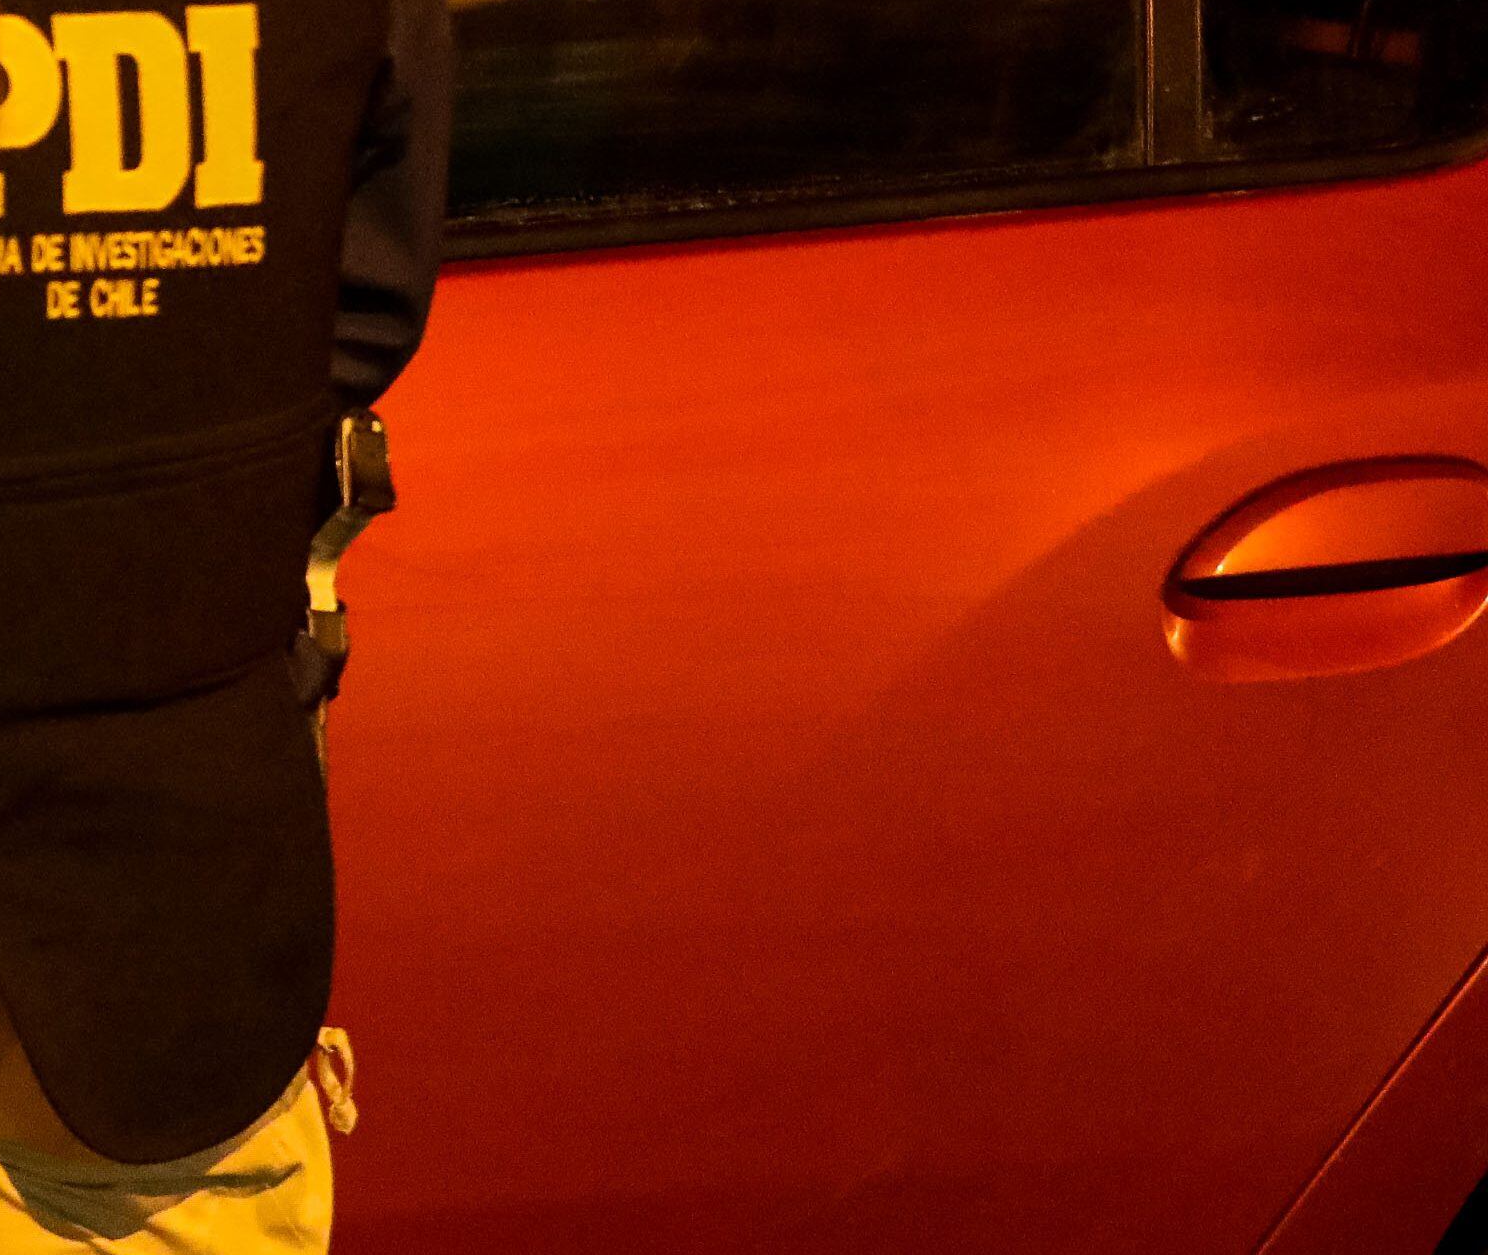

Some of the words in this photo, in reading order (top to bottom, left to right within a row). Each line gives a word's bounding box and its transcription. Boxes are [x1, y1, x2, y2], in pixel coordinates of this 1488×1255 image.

[31, 232, 66, 273] DE
[69, 226, 266, 272] INVESTIGACIONES
[46, 279, 82, 320] DE
[89, 277, 160, 318] CHILE
